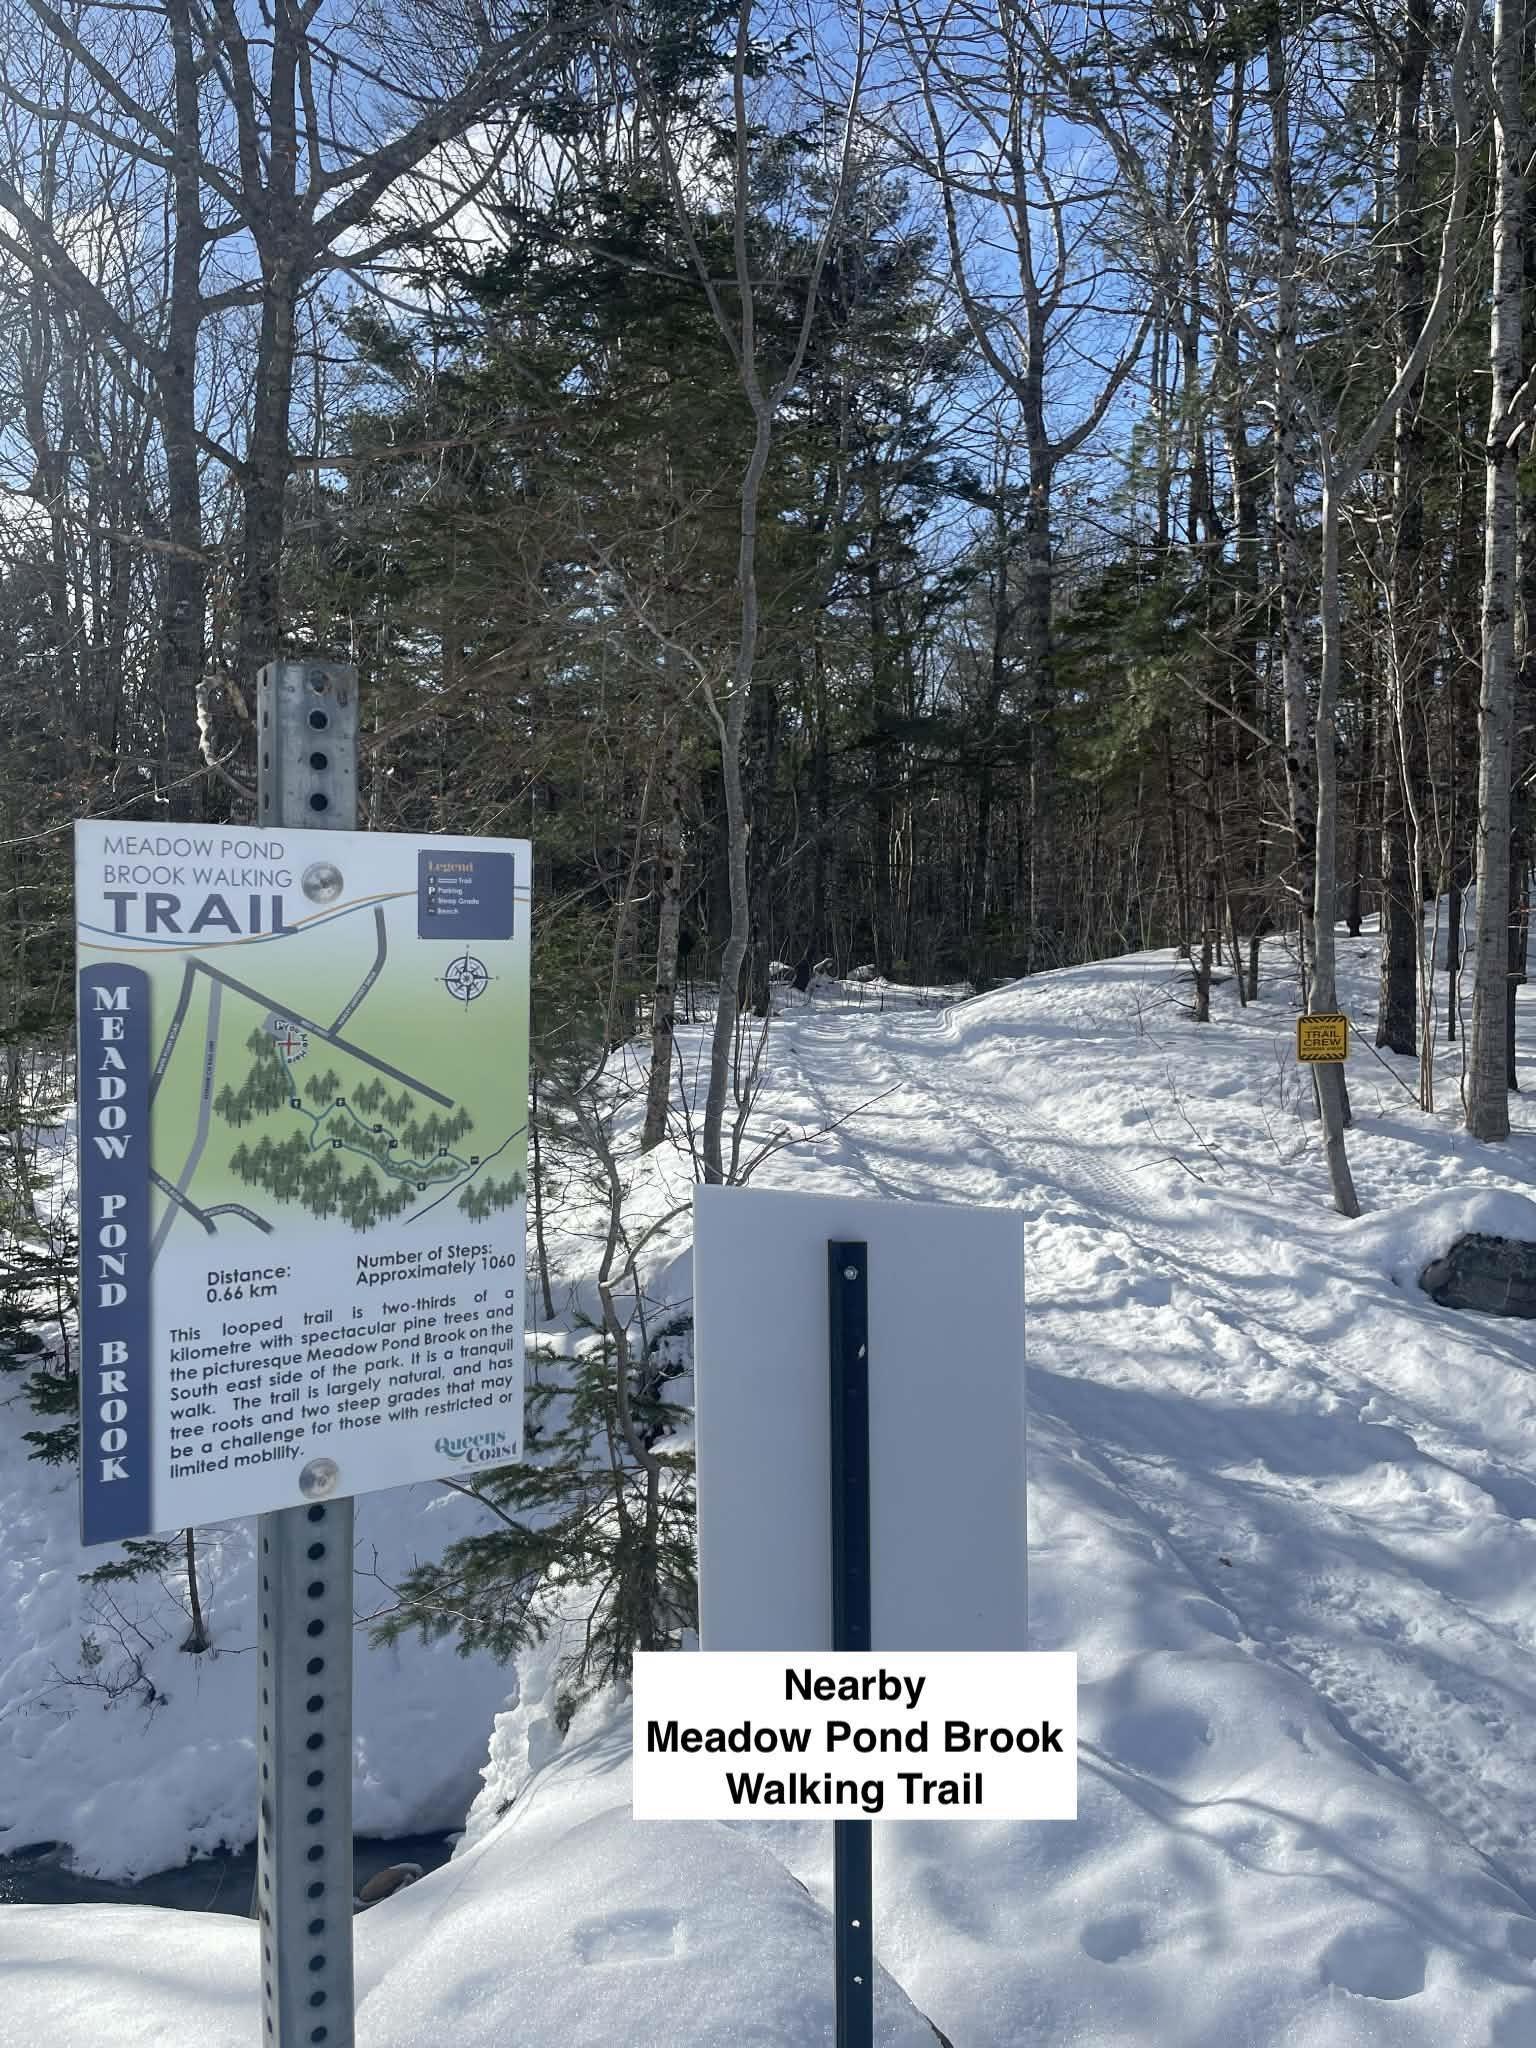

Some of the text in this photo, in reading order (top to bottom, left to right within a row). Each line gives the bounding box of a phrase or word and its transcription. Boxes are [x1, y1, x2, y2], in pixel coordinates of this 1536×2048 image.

[103, 836, 285, 860] MEADOW POND
[104, 865, 293, 888] BROOK WALKING
[428, 861, 473, 873] Legend
[103, 891, 299, 934] TRAIL
[1304, 1031, 1342, 1039] TRAIL
[91, 986, 132, 1483] MEADOW POND BROOK
[355, 1253, 516, 1288] Approximately 1060
[356, 1243, 493, 1270] Number of Steps:
[207, 1265, 291, 1287] Distance:
[206, 1283, 277, 1304] 0.66 km
[169, 1289, 514, 1343] This looped trail is two-thirds of a
[170, 1303, 514, 1363] kilometre with spectacular pine trees and
[169, 1322, 514, 1382] the picturesque Meadow Pond Brook on the
[170, 1337, 514, 1401] South east side of the park. It is a tranquil
[170, 1402, 216, 1421] walk.
[232, 1396, 262, 1411] The
[269, 1387, 300, 1405] trail
[307, 1385, 319, 1399] is
[327, 1376, 381, 1397] largely
[452, 1359, 482, 1377] and
[488, 1358, 513, 1371] has
[169, 1375, 513, 1441] tree roots and two steep grades that may
[170, 1392, 513, 1460] be a challenge for those with restricted or
[434, 1431, 506, 1458] Queens
[466, 1440, 517, 1463] Coast
[170, 1445, 305, 1479] limited mobility.
